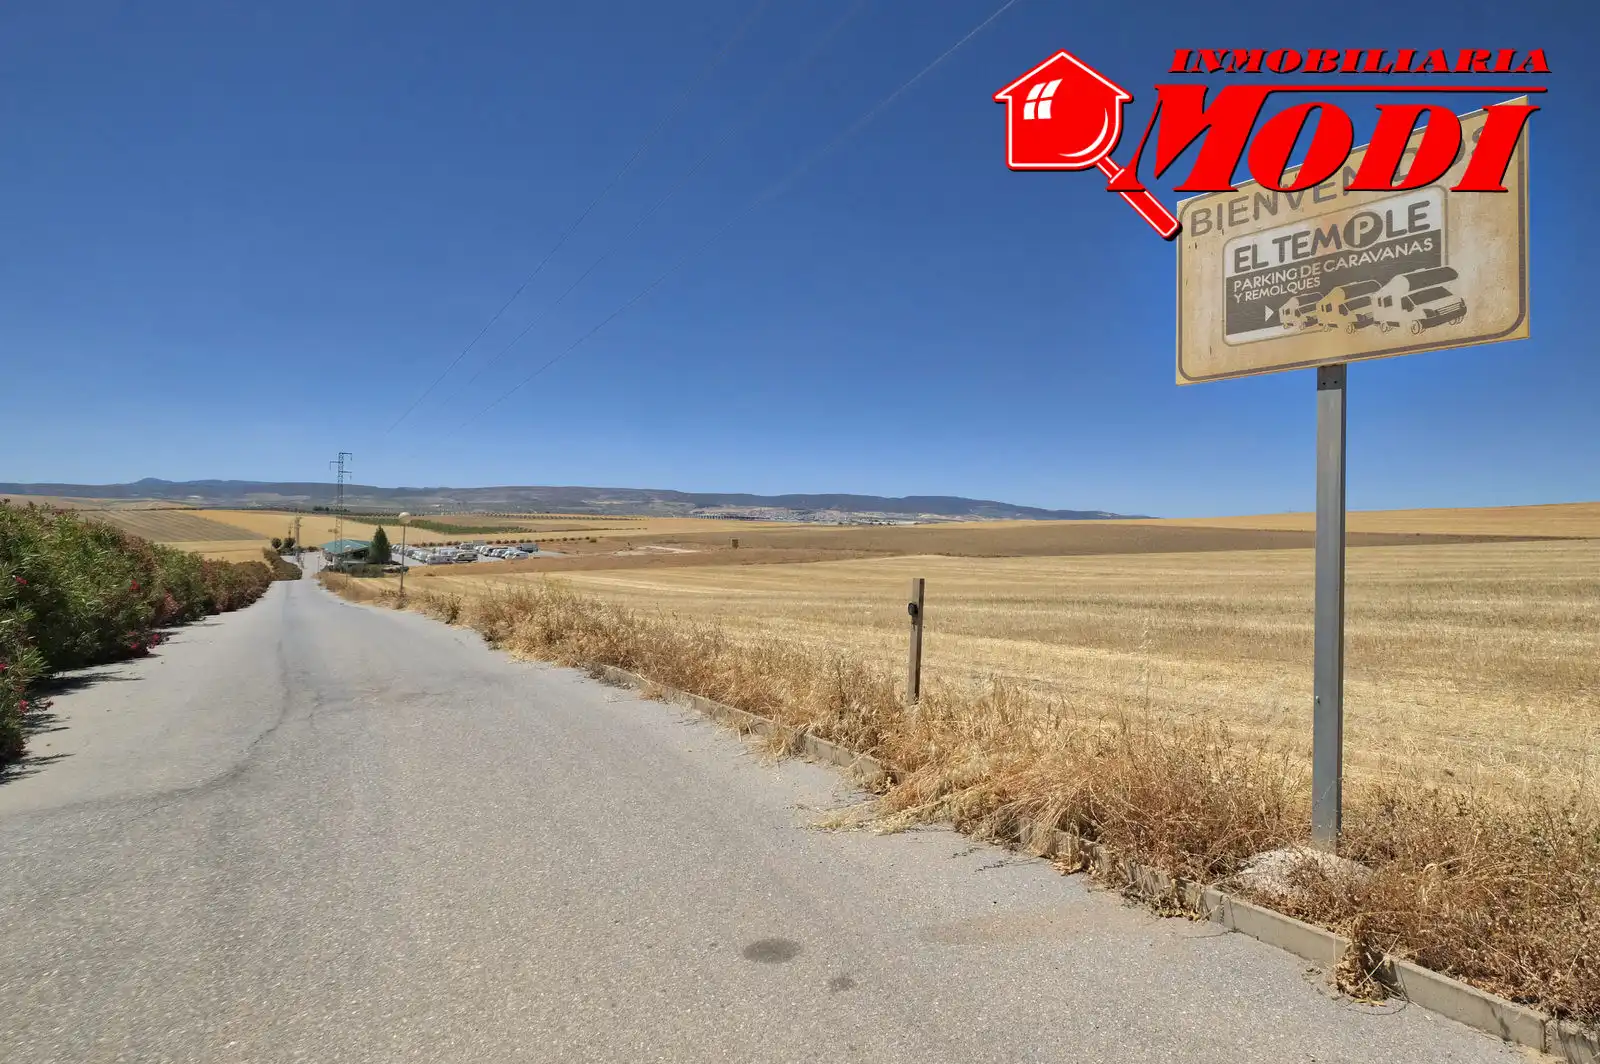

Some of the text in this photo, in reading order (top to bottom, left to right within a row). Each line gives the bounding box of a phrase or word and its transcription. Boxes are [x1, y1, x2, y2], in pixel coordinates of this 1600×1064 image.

[1233, 199, 1431, 274] EL TEMPLE
[1233, 237, 1433, 293] PARKING DE CARAVANAS
[1233, 276, 1321, 304] Y REMOLQUES
